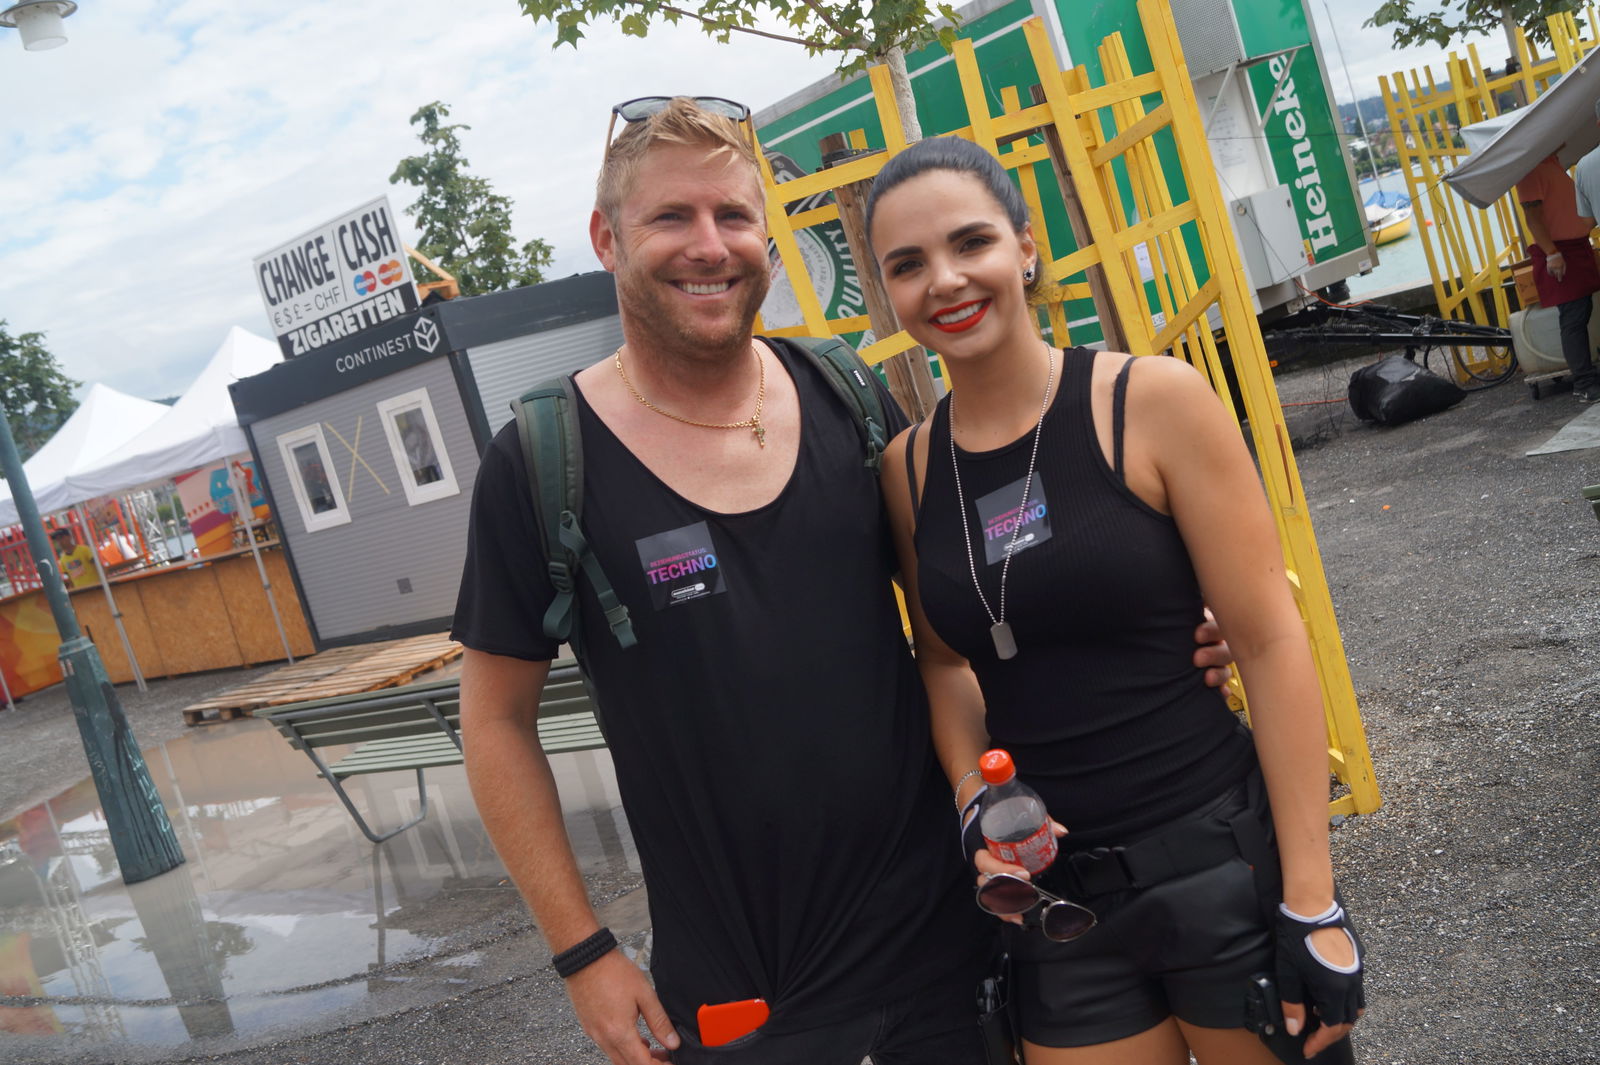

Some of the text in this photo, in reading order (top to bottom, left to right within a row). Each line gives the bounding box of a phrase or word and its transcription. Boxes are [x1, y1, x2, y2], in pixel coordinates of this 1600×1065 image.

[338, 207, 397, 271] CASH
[259, 236, 336, 307] CHANGE
[314, 286, 342, 311] CHF
[288, 288, 406, 356] ZIGARETTEN
[335, 334, 412, 373] CONTINEST
[984, 503, 1047, 541] TECHNO
[646, 553, 717, 585] TECHNO
